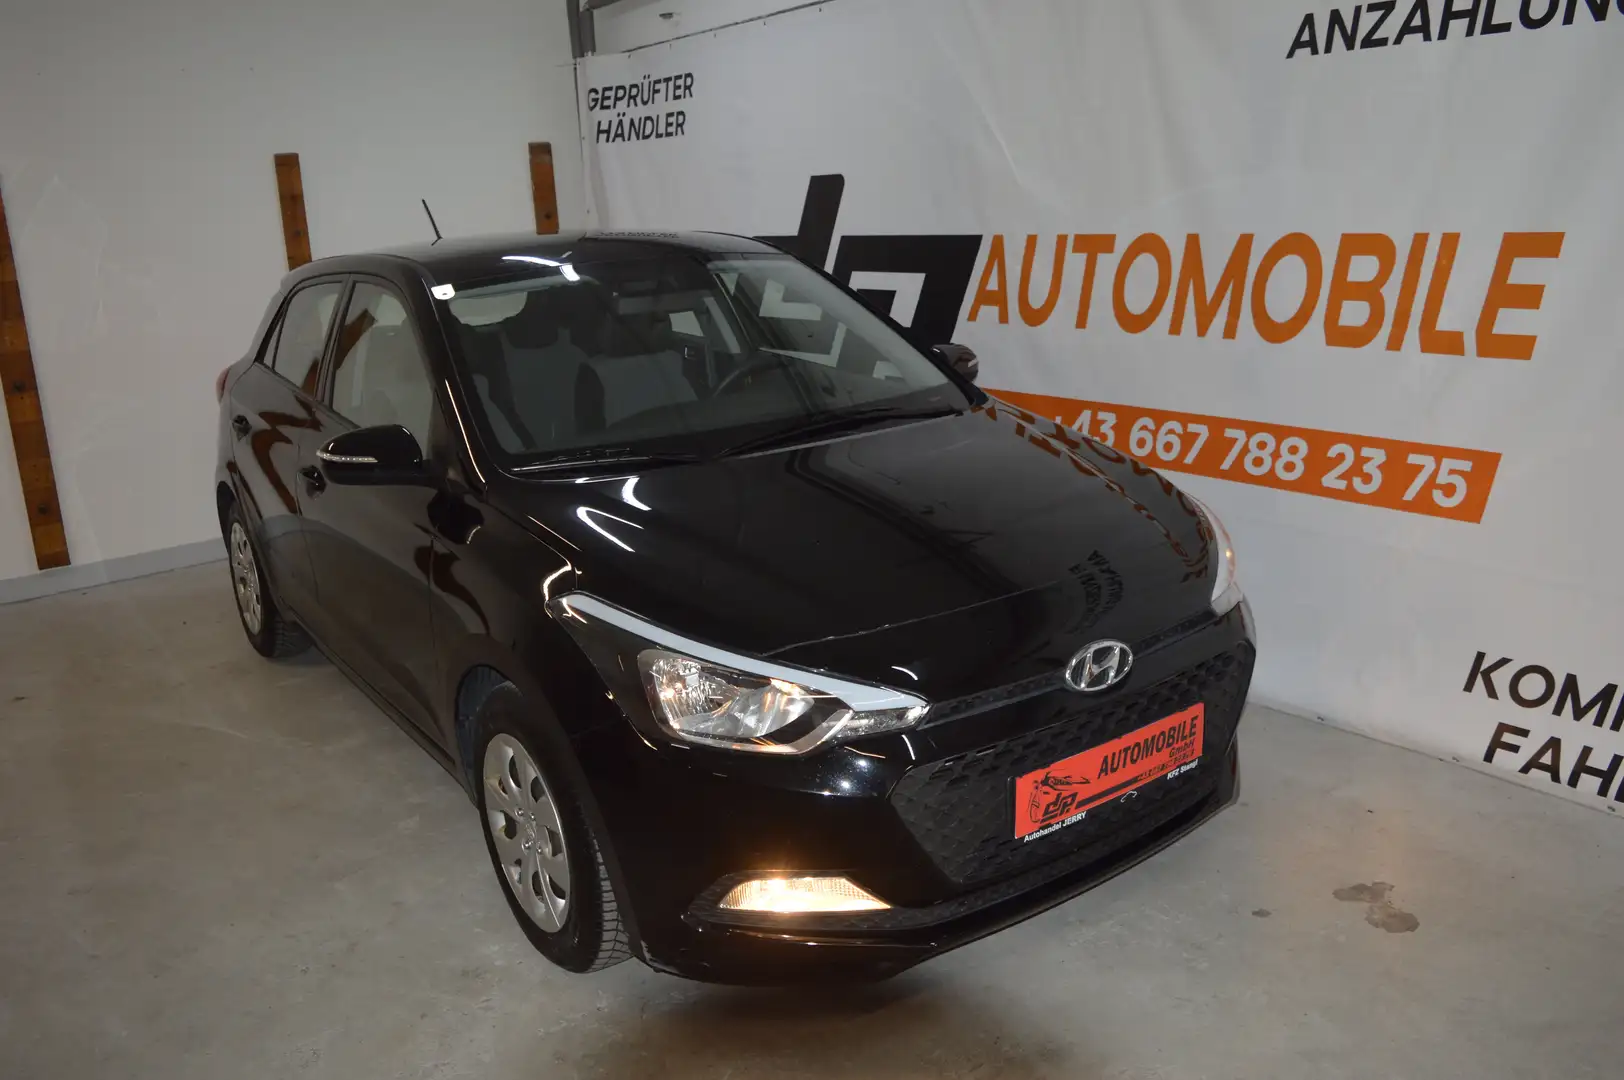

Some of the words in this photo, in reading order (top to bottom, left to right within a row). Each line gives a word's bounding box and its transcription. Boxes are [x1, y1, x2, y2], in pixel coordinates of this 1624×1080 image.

[1285, 0, 1624, 59] ANZAHLU
[588, 72, 694, 112] GEPRÜFTER
[596, 110, 686, 144] HÄNDLER
[967, 232, 1565, 361] AUTOMOBILE
[1129, 416, 1210, 465] 667
[1221, 430, 1309, 482] 788
[1321, 443, 1387, 495] 23
[1402, 455, 1473, 508] 75
[1098, 715, 1199, 780] AUTOMOBILE
[1483, 722, 1624, 803] FAH
[1024, 822, 1062, 843] Autohandel
[1062, 811, 1087, 827] JERRY
